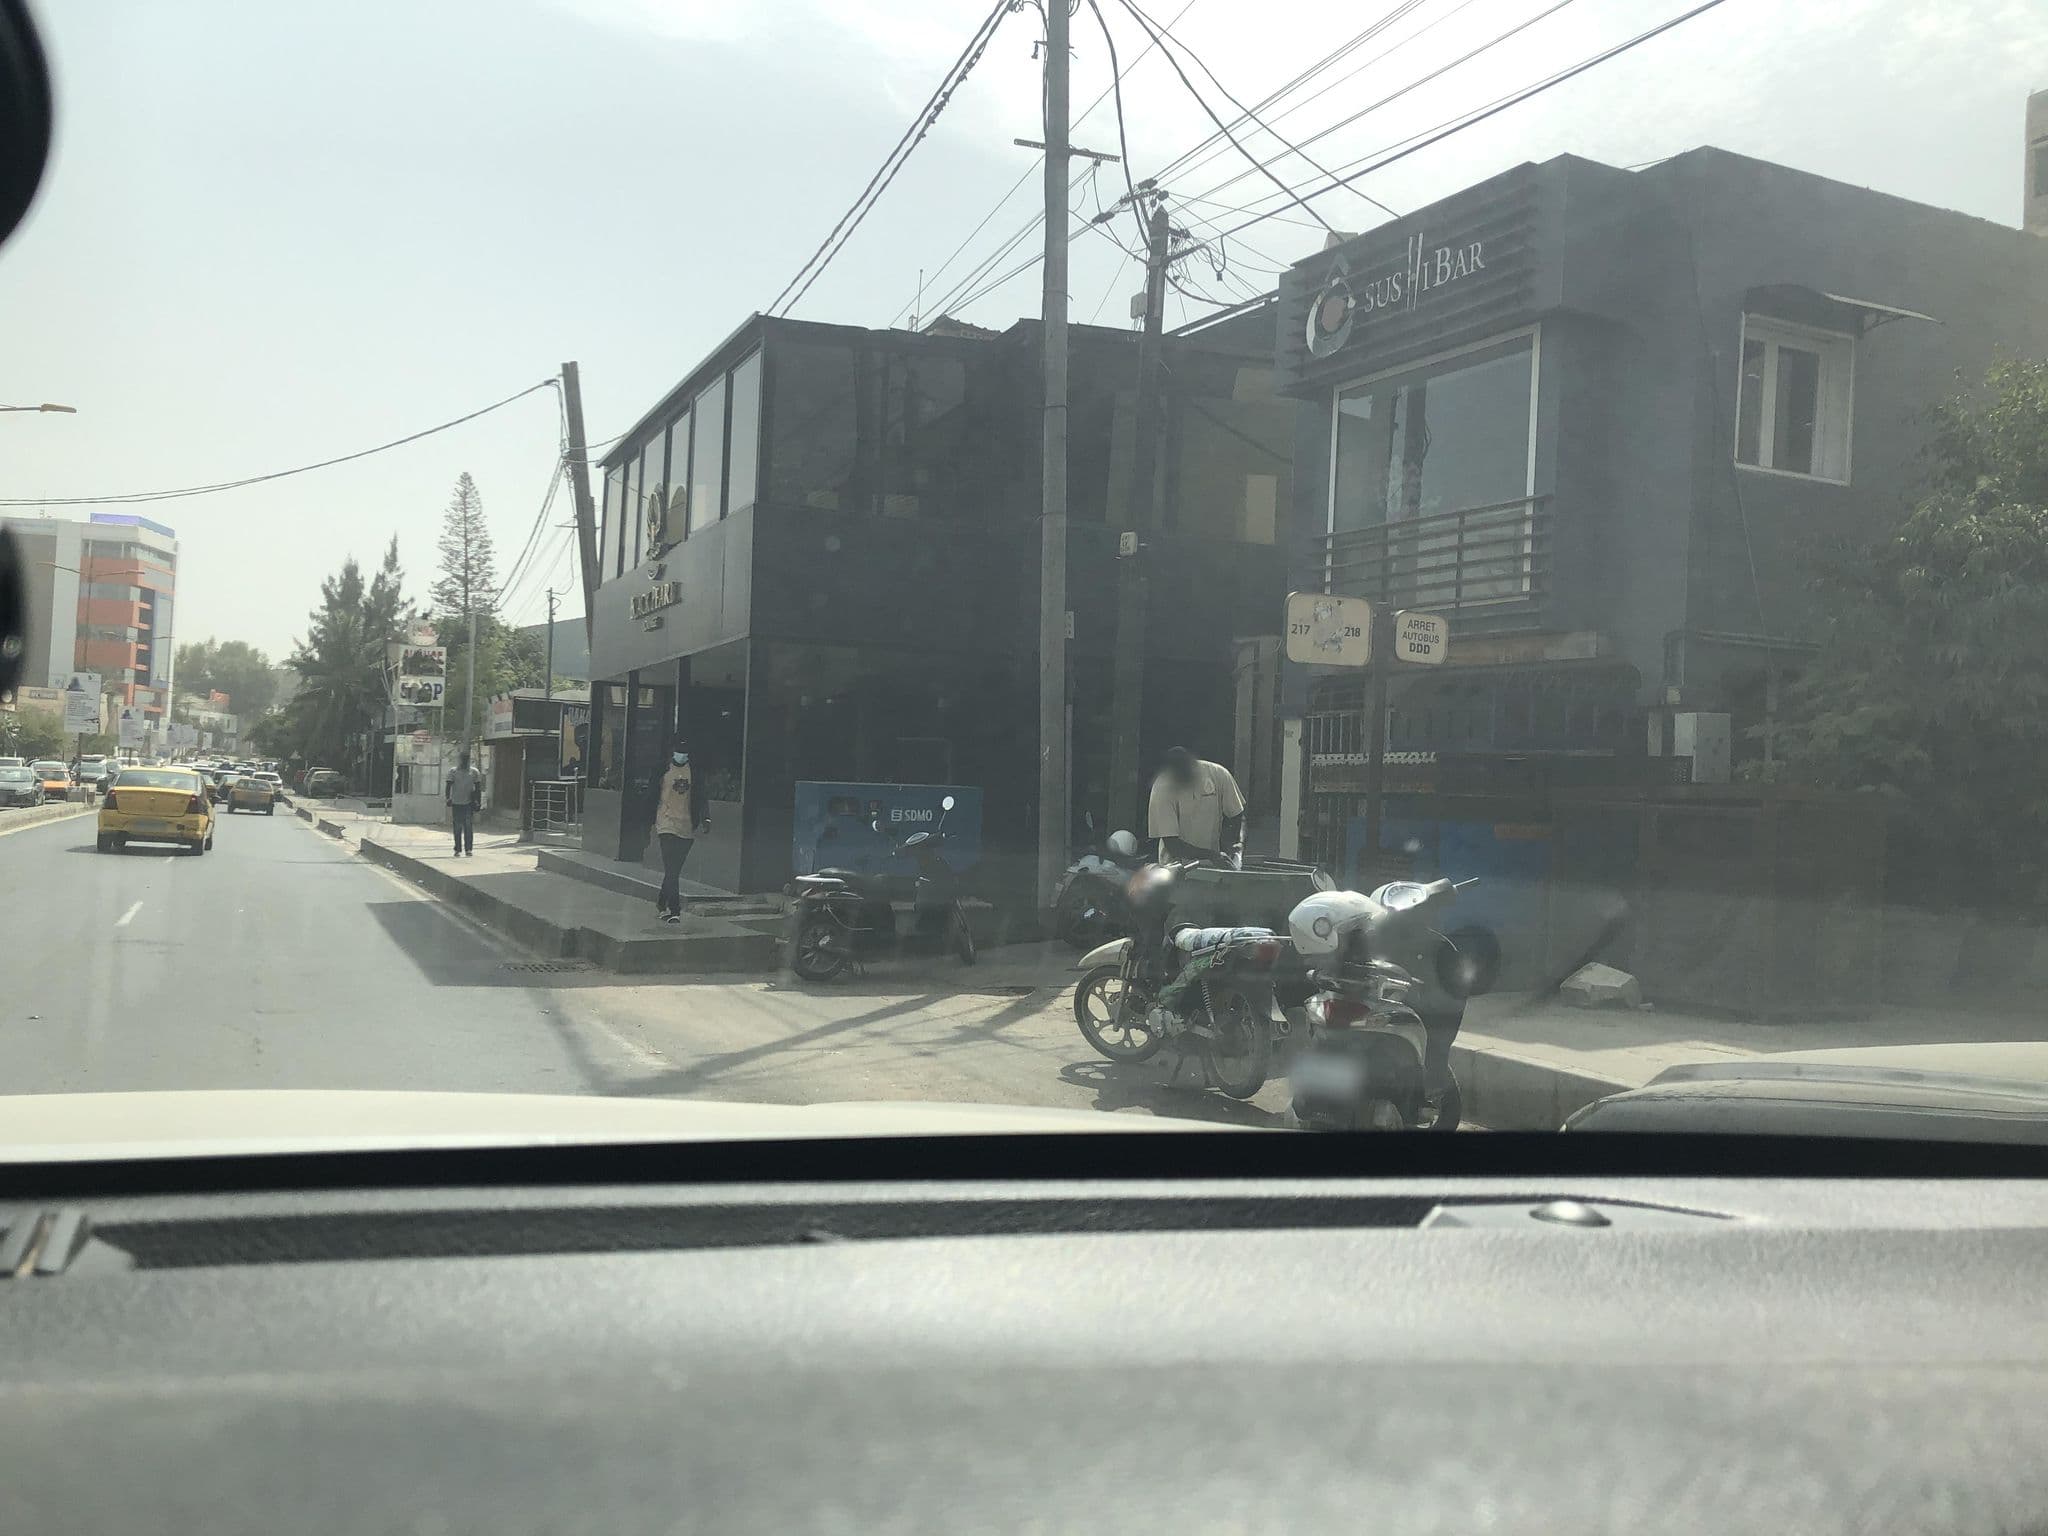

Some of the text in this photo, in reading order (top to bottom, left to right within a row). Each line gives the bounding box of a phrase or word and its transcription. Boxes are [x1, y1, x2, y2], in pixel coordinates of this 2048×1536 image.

[1364, 232, 1486, 313] SUSHI BAR
[1291, 623, 1311, 635] 217
[1407, 620, 1436, 631] ARRET
[1344, 627, 1361, 637] 218
[1402, 630, 1440, 644] AUTOBUS
[1409, 643, 1430, 654] DDD
[904, 810, 932, 821] SDMO
